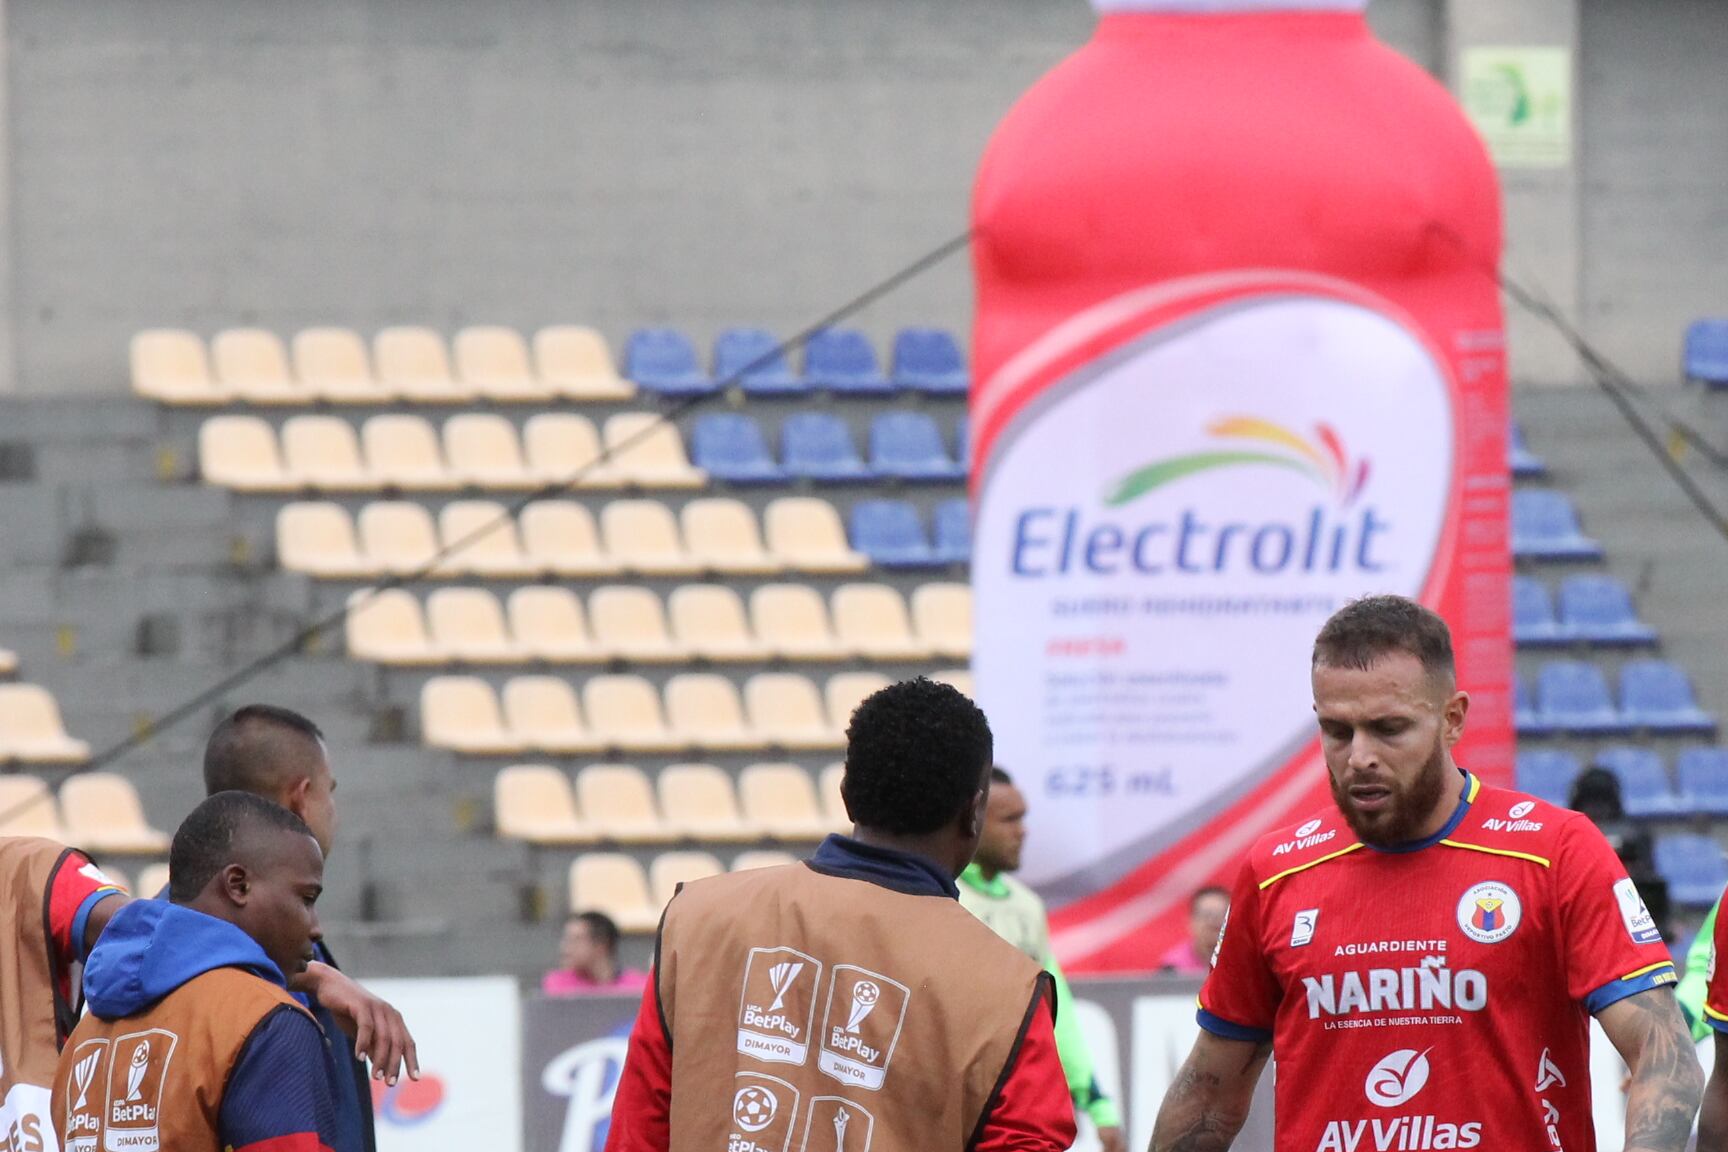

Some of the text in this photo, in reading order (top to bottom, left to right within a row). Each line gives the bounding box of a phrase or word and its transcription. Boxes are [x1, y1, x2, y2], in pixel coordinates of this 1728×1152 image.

[1011, 503, 1391, 578] Electrolit
[1482, 815, 1543, 833] AV Villas
[1272, 828, 1337, 856] AV Villas
[1334, 940, 1447, 956] AGUARDIENTE
[1301, 955, 1487, 1020] NARIÑO
[743, 1010, 800, 1039] BetPlay
[1324, 1015, 1462, 1030] LA ESENCIA DE NUESTRA TIERRA
[744, 1038, 791, 1057] DIMAYOR
[1370, 1114, 1482, 1152] Villas
